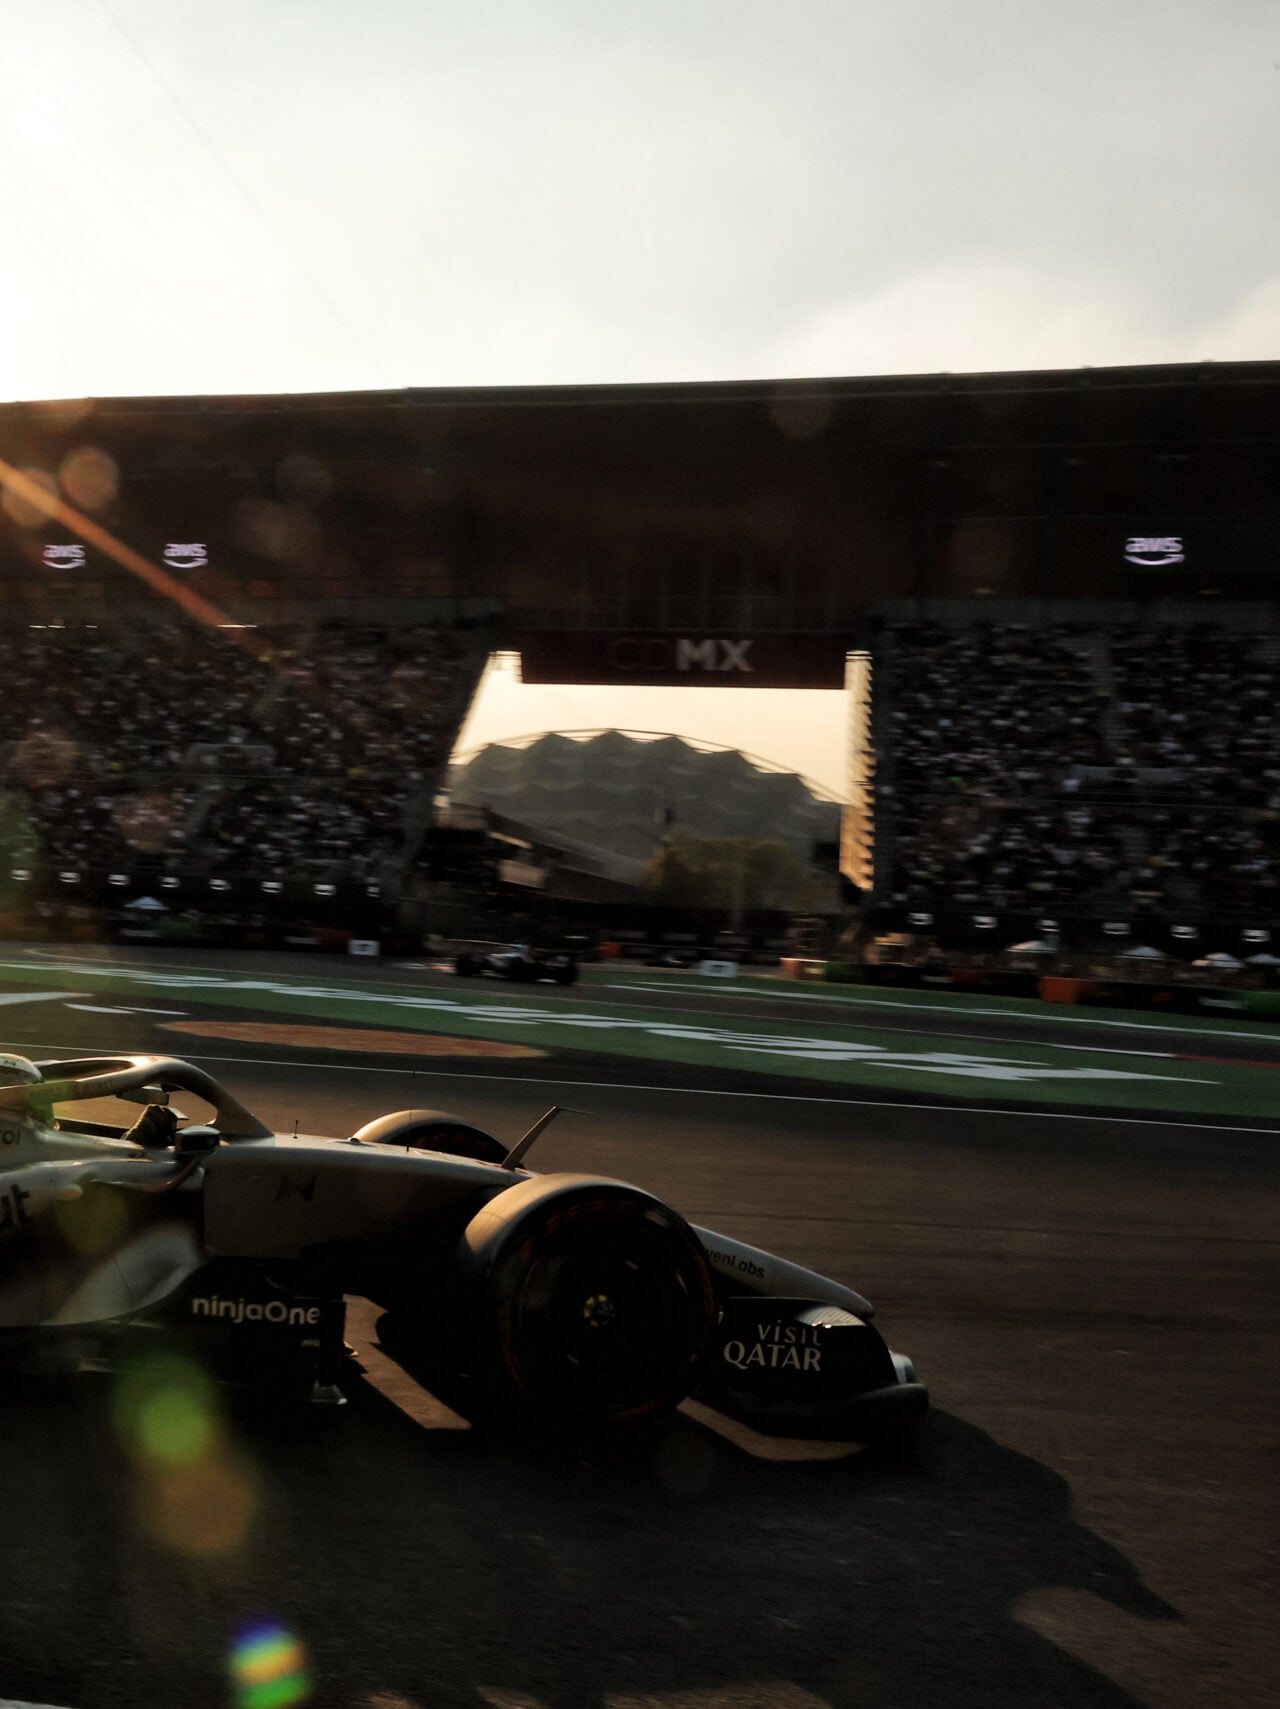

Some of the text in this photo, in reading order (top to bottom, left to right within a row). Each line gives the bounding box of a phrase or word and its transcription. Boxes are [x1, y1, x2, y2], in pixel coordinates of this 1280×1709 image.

[42, 544, 86, 559] aws
[163, 543, 208, 558] aws
[1124, 536, 1184, 553] aws
[192, 1294, 321, 1325] ninjaOne
[722, 1340, 822, 1372] QATAR
